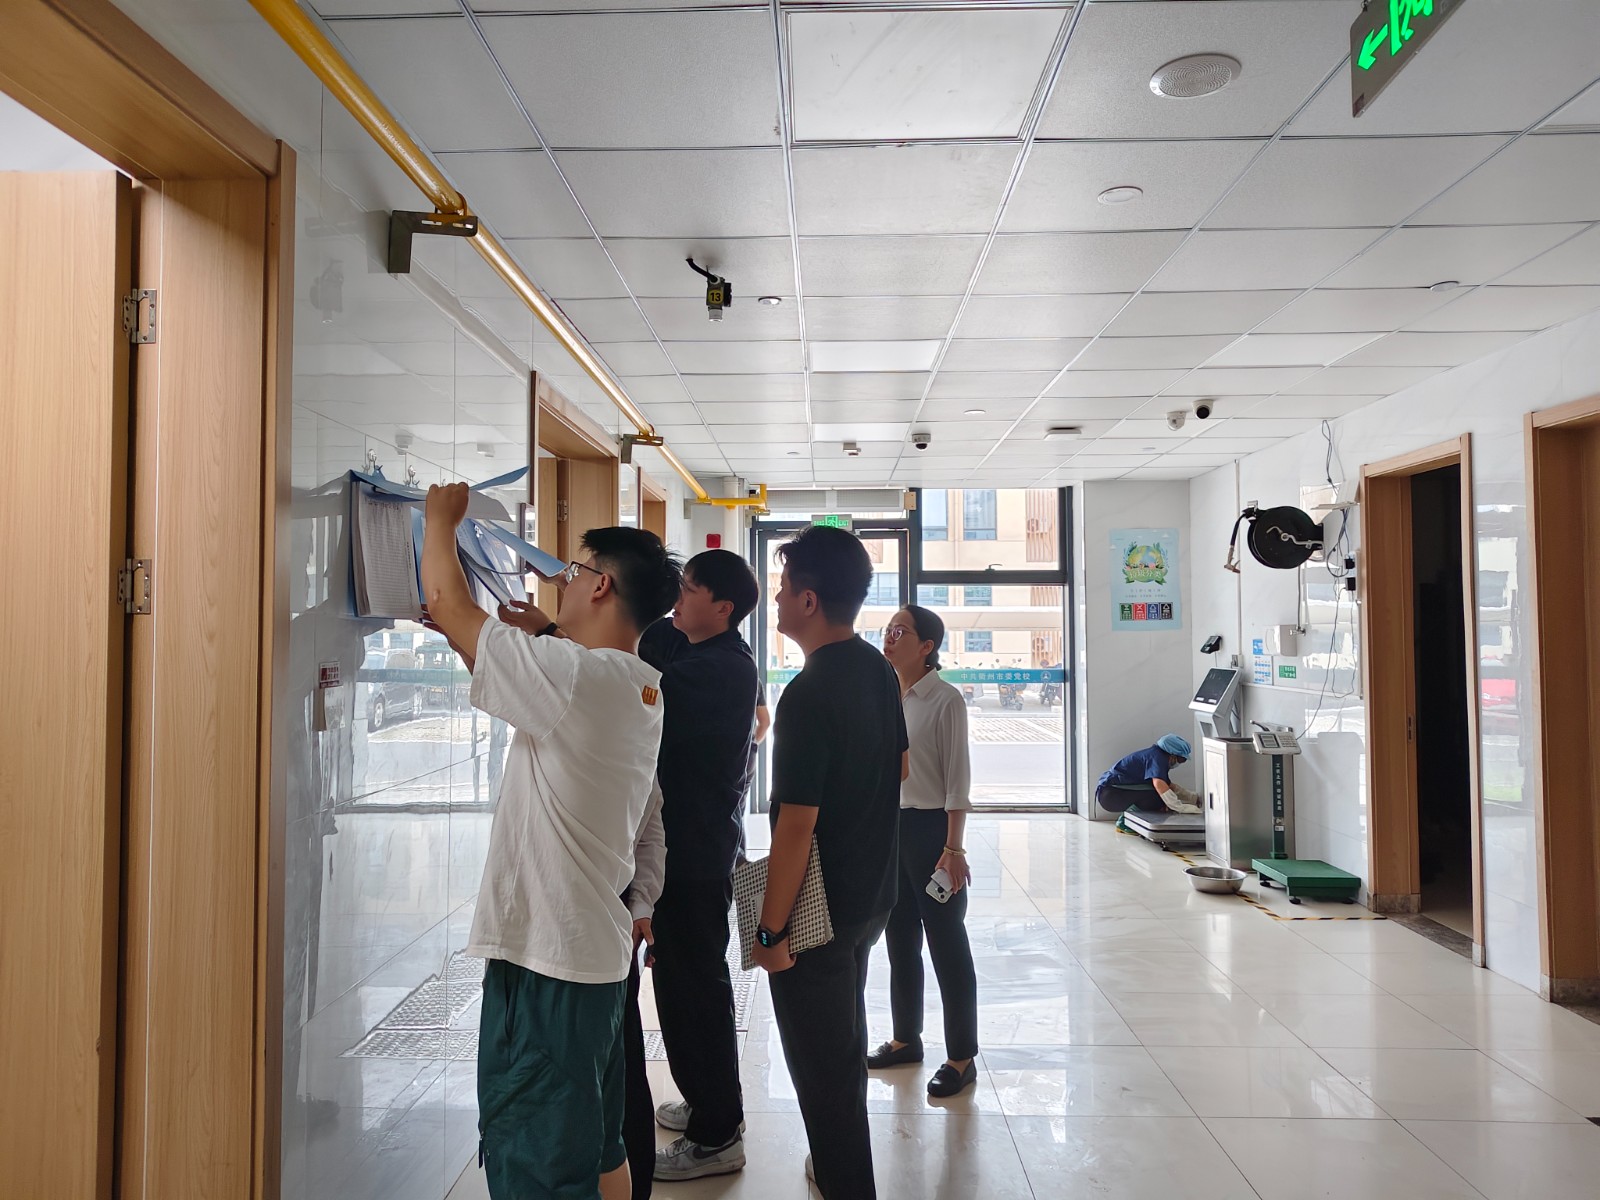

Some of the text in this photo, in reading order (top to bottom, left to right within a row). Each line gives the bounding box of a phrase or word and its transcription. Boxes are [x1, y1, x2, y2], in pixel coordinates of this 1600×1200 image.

[710, 292, 721, 302] 13
[960, 672, 1031, 681] 中共衢州市委党校
